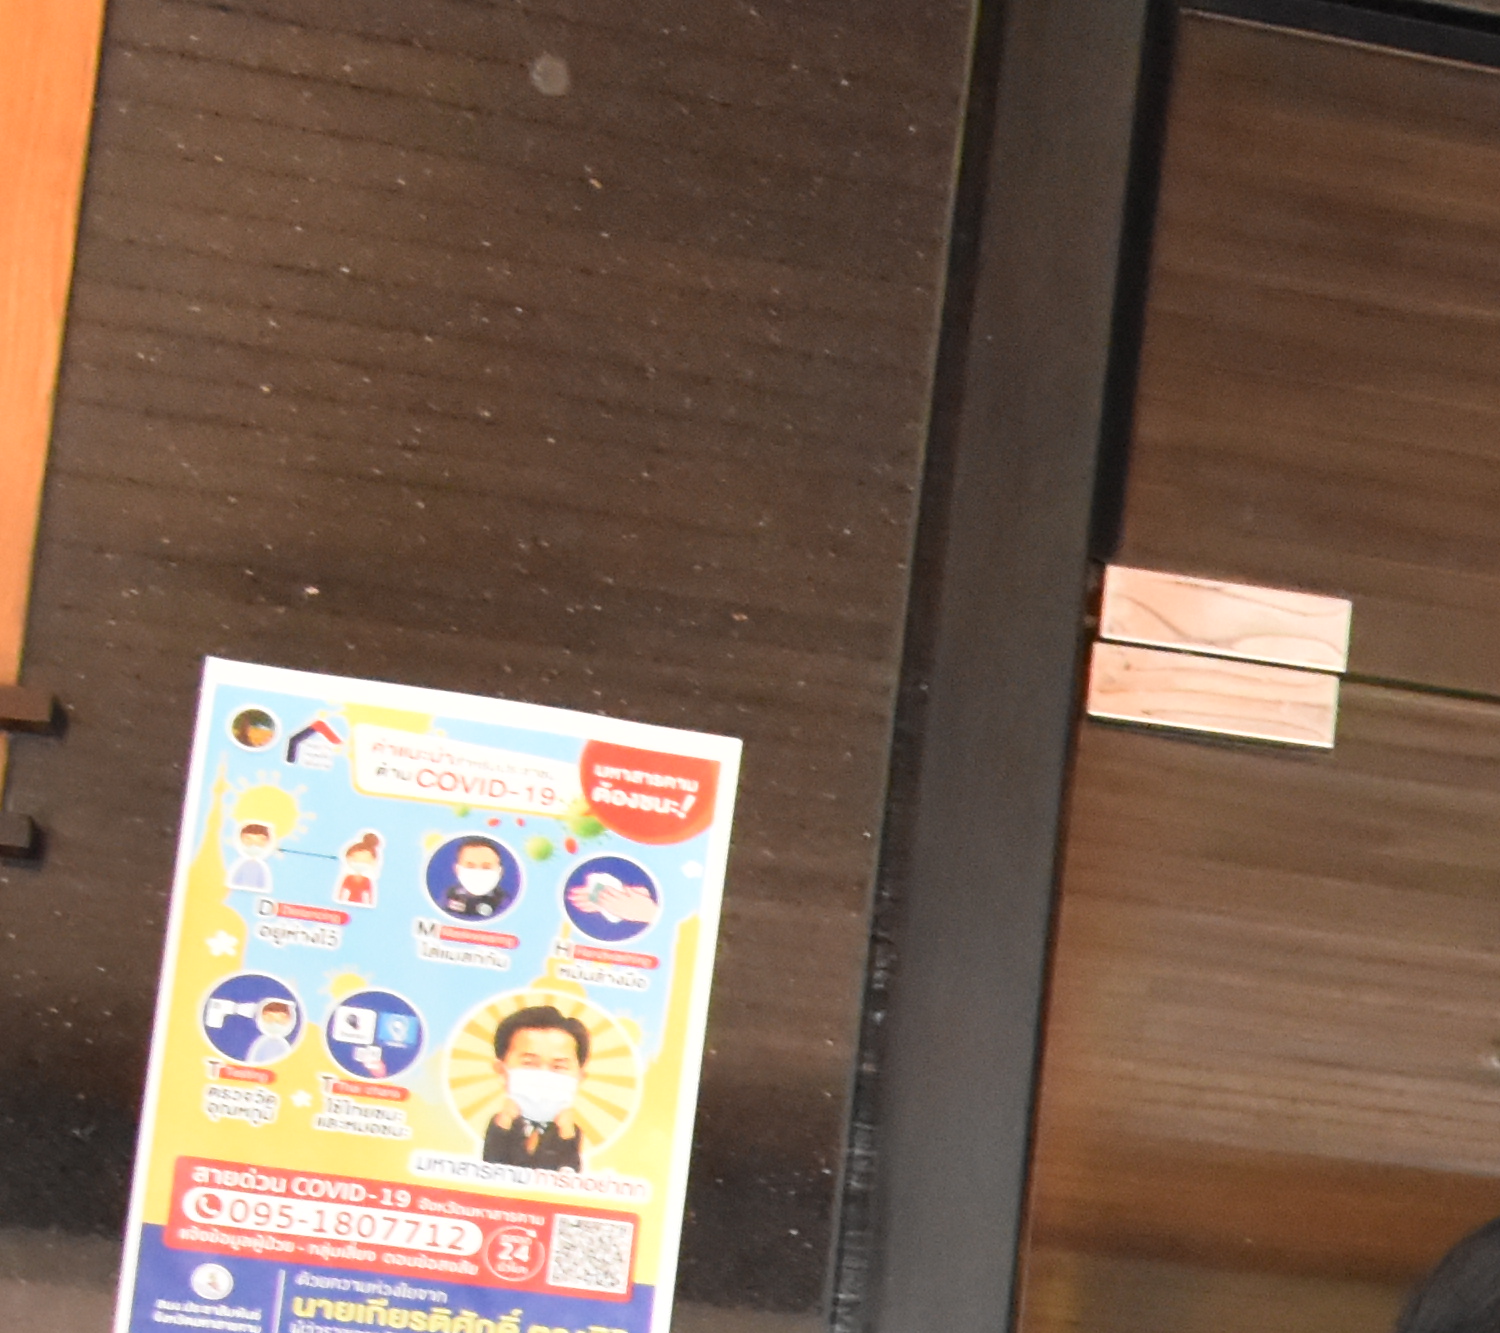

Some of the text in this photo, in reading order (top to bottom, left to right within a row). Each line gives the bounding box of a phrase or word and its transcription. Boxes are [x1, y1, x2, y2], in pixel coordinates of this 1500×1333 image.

[416, 767, 557, 806] COVID-19
[593, 763, 699, 792] มหาสารคาม
[191, 1165, 287, 1193] สายด่วน
[291, 1177, 412, 1208] COVID-19
[228, 1198, 466, 1251] 095-1807712
[498, 1241, 530, 1263] 24
